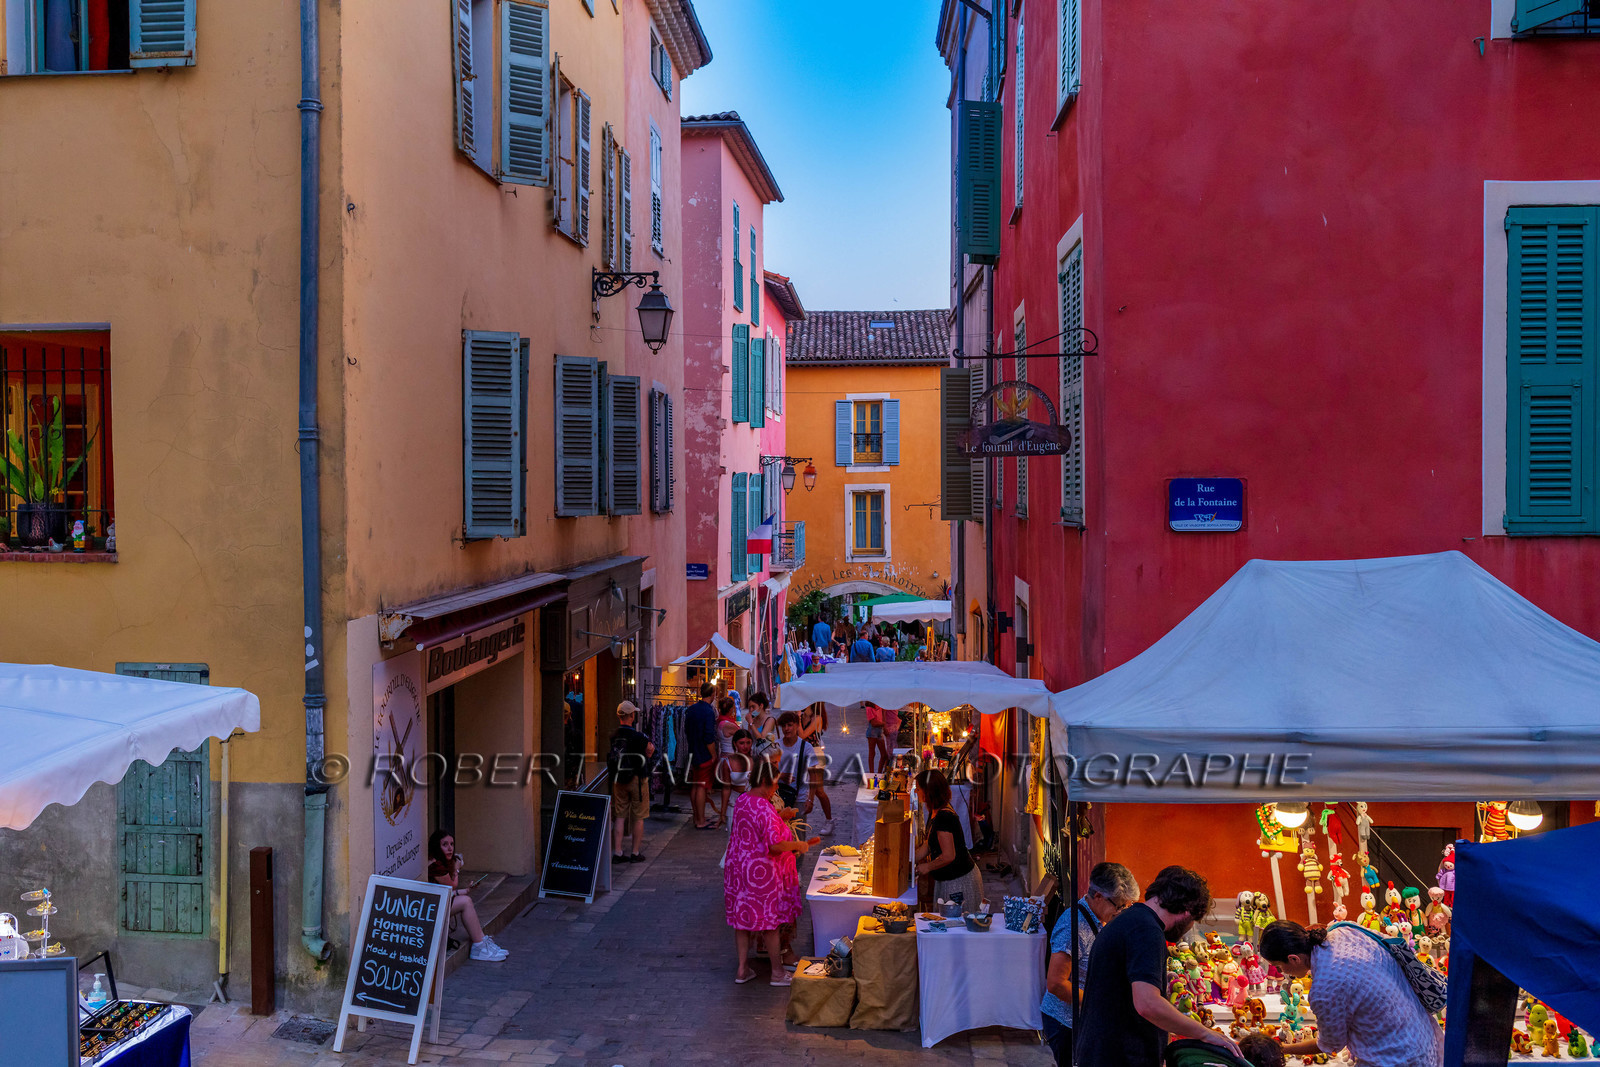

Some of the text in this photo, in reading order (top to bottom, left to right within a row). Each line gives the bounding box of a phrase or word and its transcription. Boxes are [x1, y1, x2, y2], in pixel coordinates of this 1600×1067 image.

[965, 440, 1061, 455] Le fournil d'Eugène
[1197, 483, 1215, 493] Rue
[1174, 497, 1238, 507] de la Fontaine
[428, 618, 525, 683] Boulangerie
[374, 890, 437, 922] JUNGLE
[373, 918, 425, 937] HOMMES
[371, 929, 425, 948] FEMMES
[361, 959, 423, 997] SOLDES
